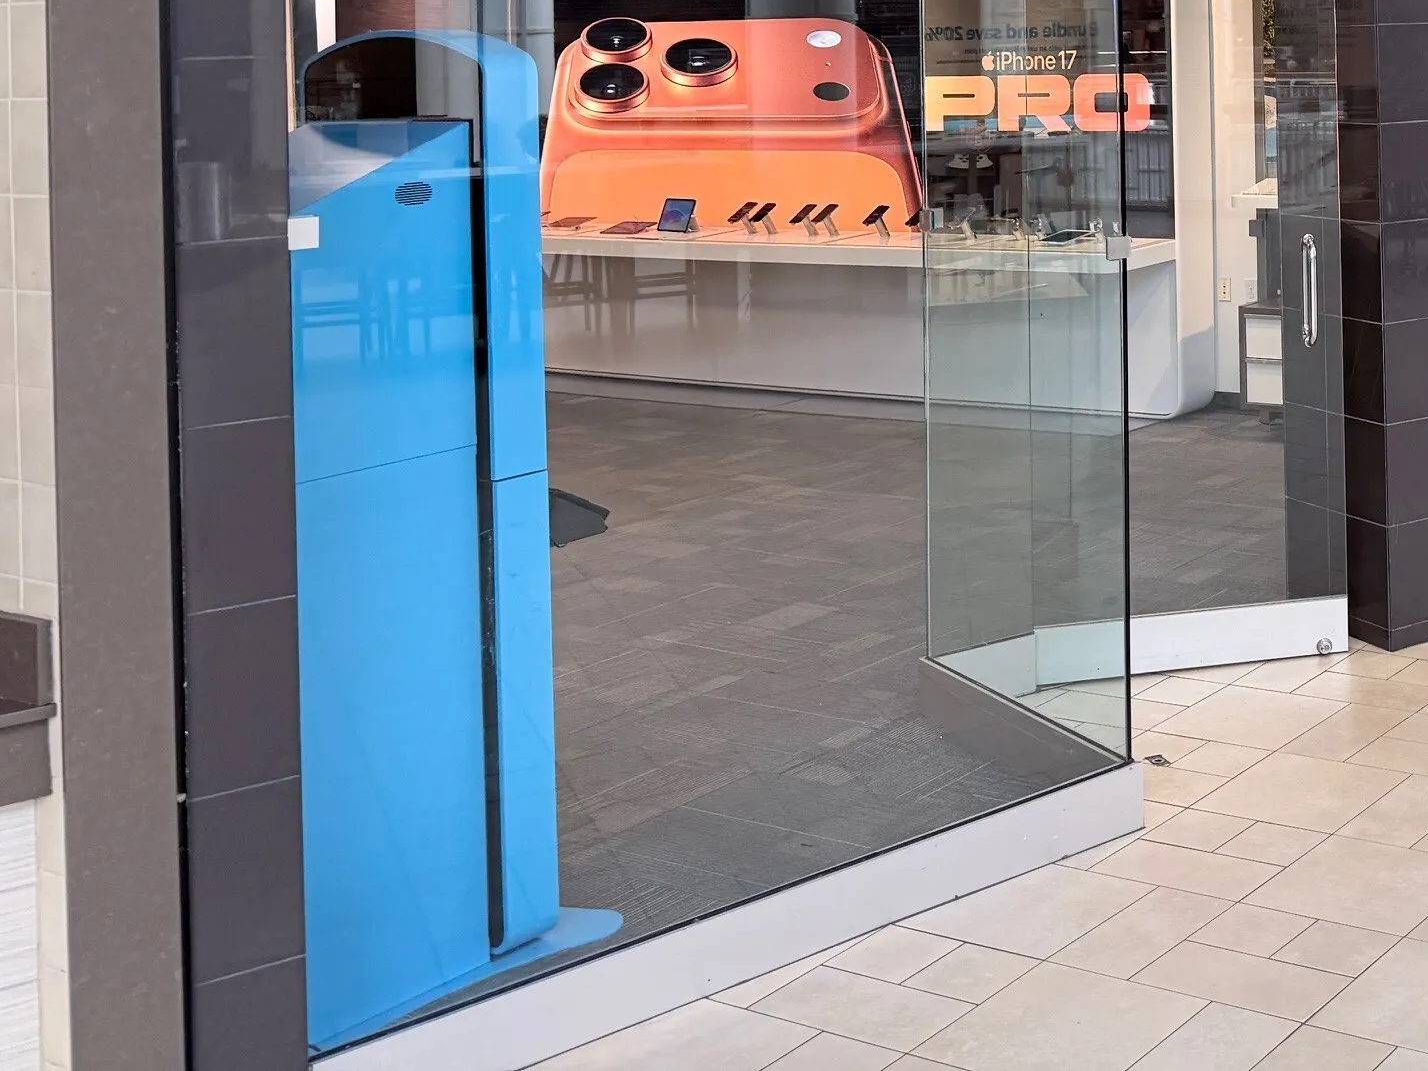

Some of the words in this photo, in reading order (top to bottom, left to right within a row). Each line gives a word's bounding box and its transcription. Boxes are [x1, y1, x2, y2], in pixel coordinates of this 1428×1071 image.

[997, 51, 1056, 71] iPhone
[1058, 50, 1077, 70] 17
[925, 73, 1151, 133] PRO
